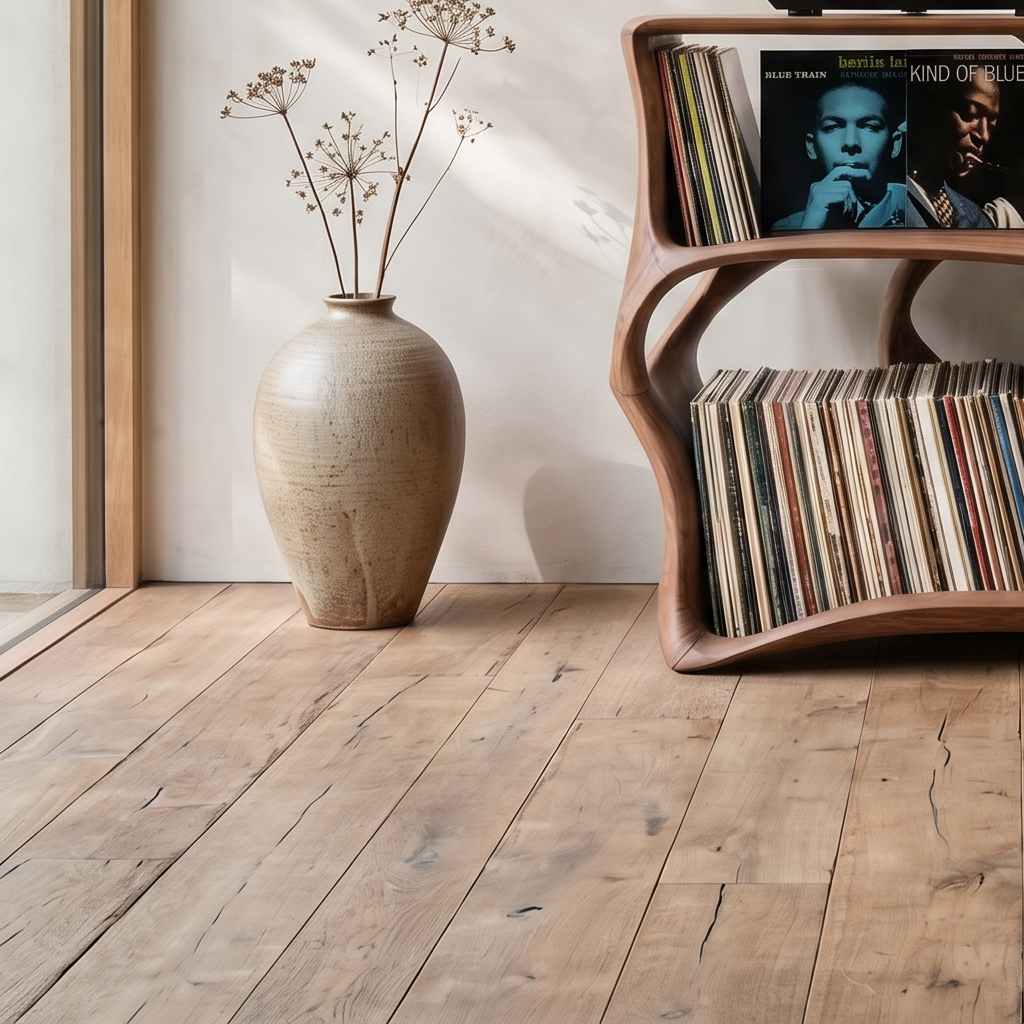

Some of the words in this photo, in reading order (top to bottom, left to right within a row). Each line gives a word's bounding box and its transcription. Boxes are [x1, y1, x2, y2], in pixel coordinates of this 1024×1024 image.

[794, 71, 827, 79] TRAIN
[910, 64, 950, 82] KIND
[956, 64, 978, 82] OF
